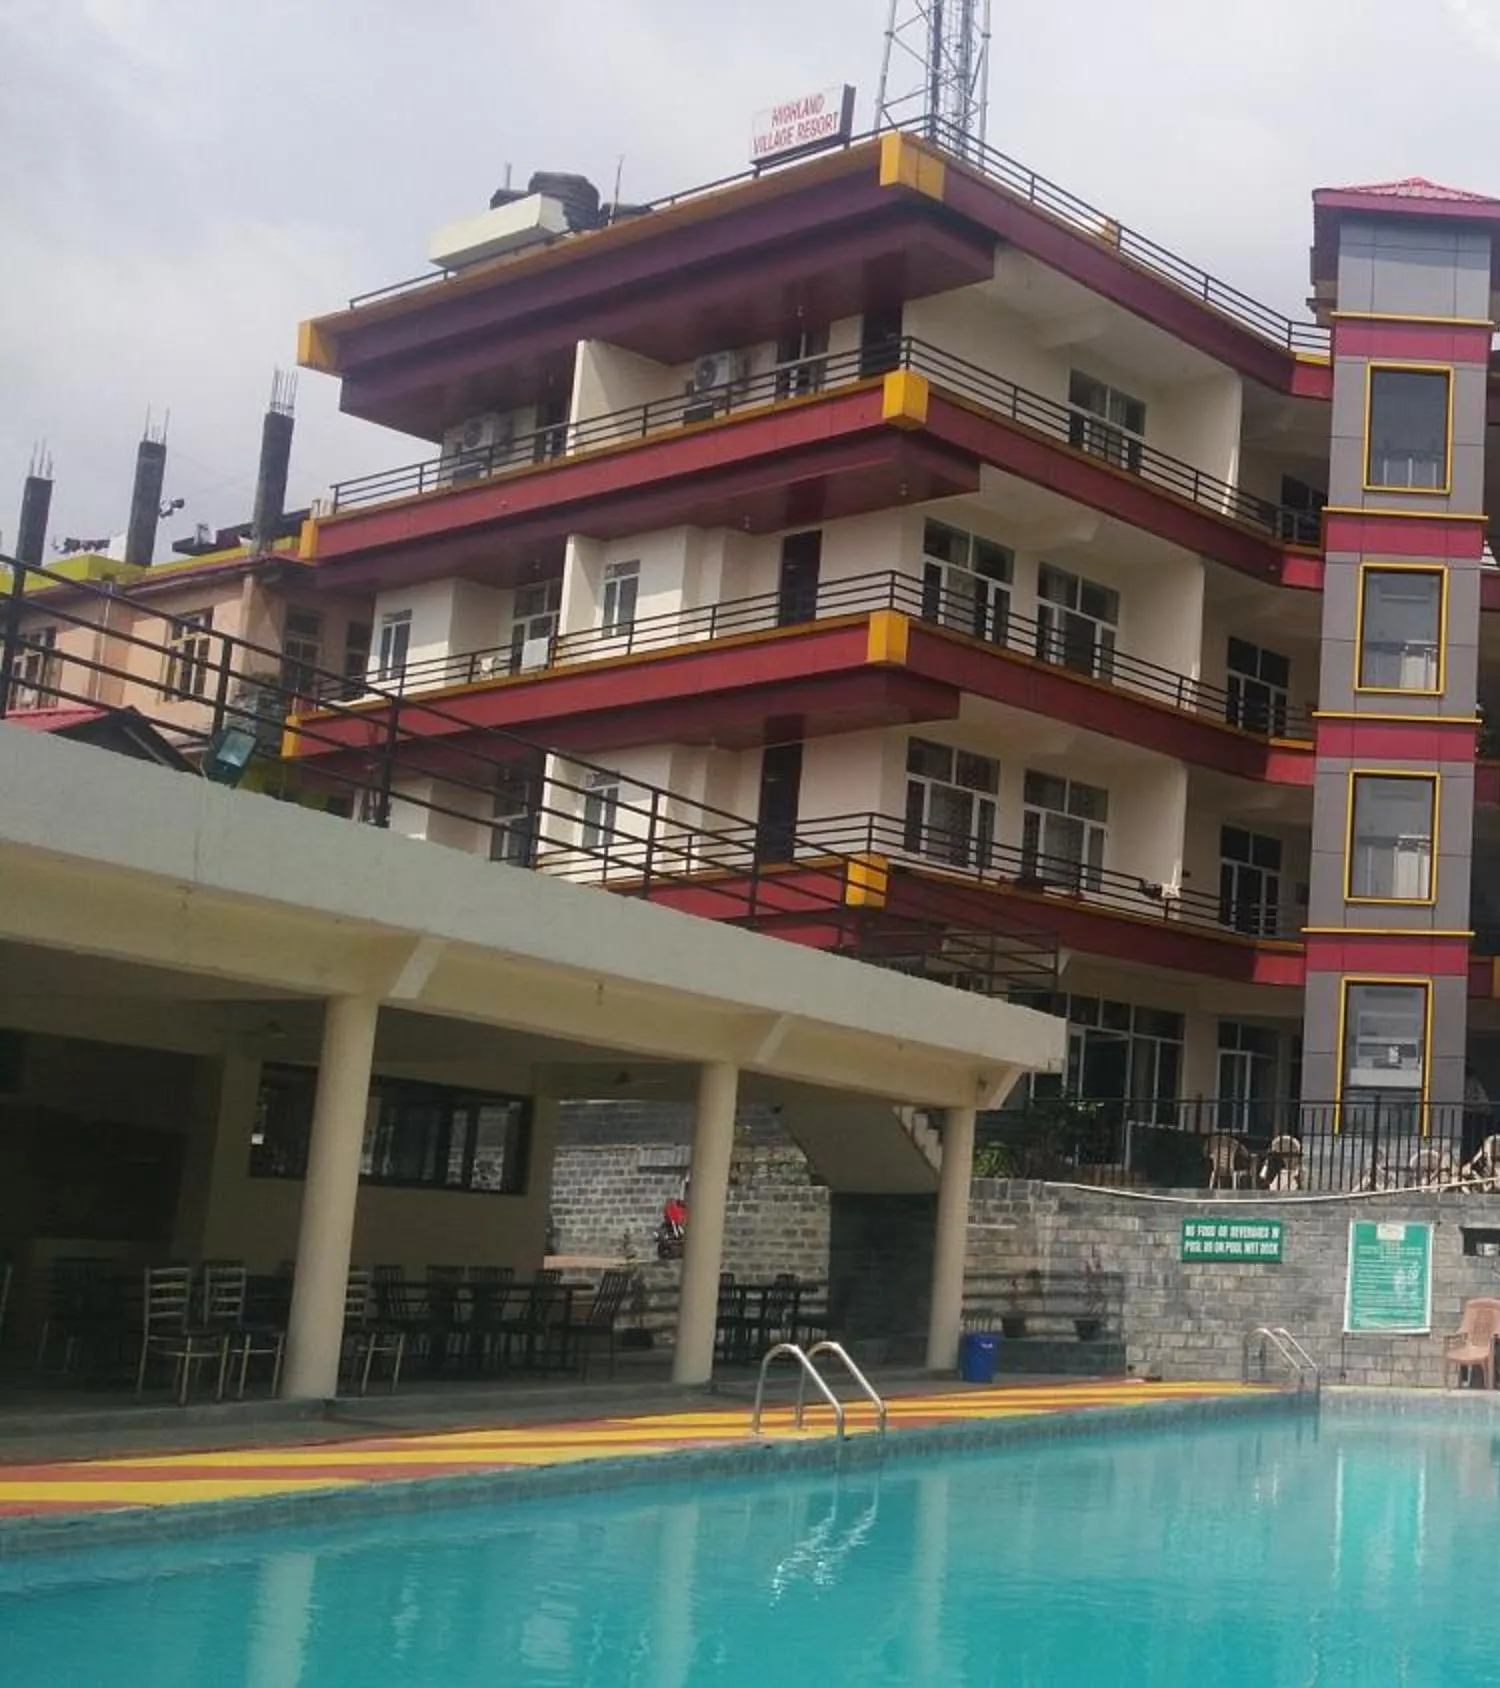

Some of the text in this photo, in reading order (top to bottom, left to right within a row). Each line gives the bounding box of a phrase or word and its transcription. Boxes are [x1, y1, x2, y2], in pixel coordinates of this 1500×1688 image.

[753, 111, 838, 155] VILLAGE RESORT
[1197, 1225, 1216, 1237] FOOD
[1184, 1240, 1202, 1253] POOL
[1225, 1241, 1242, 1254] POOL
[1259, 1242, 1278, 1255] DECK
